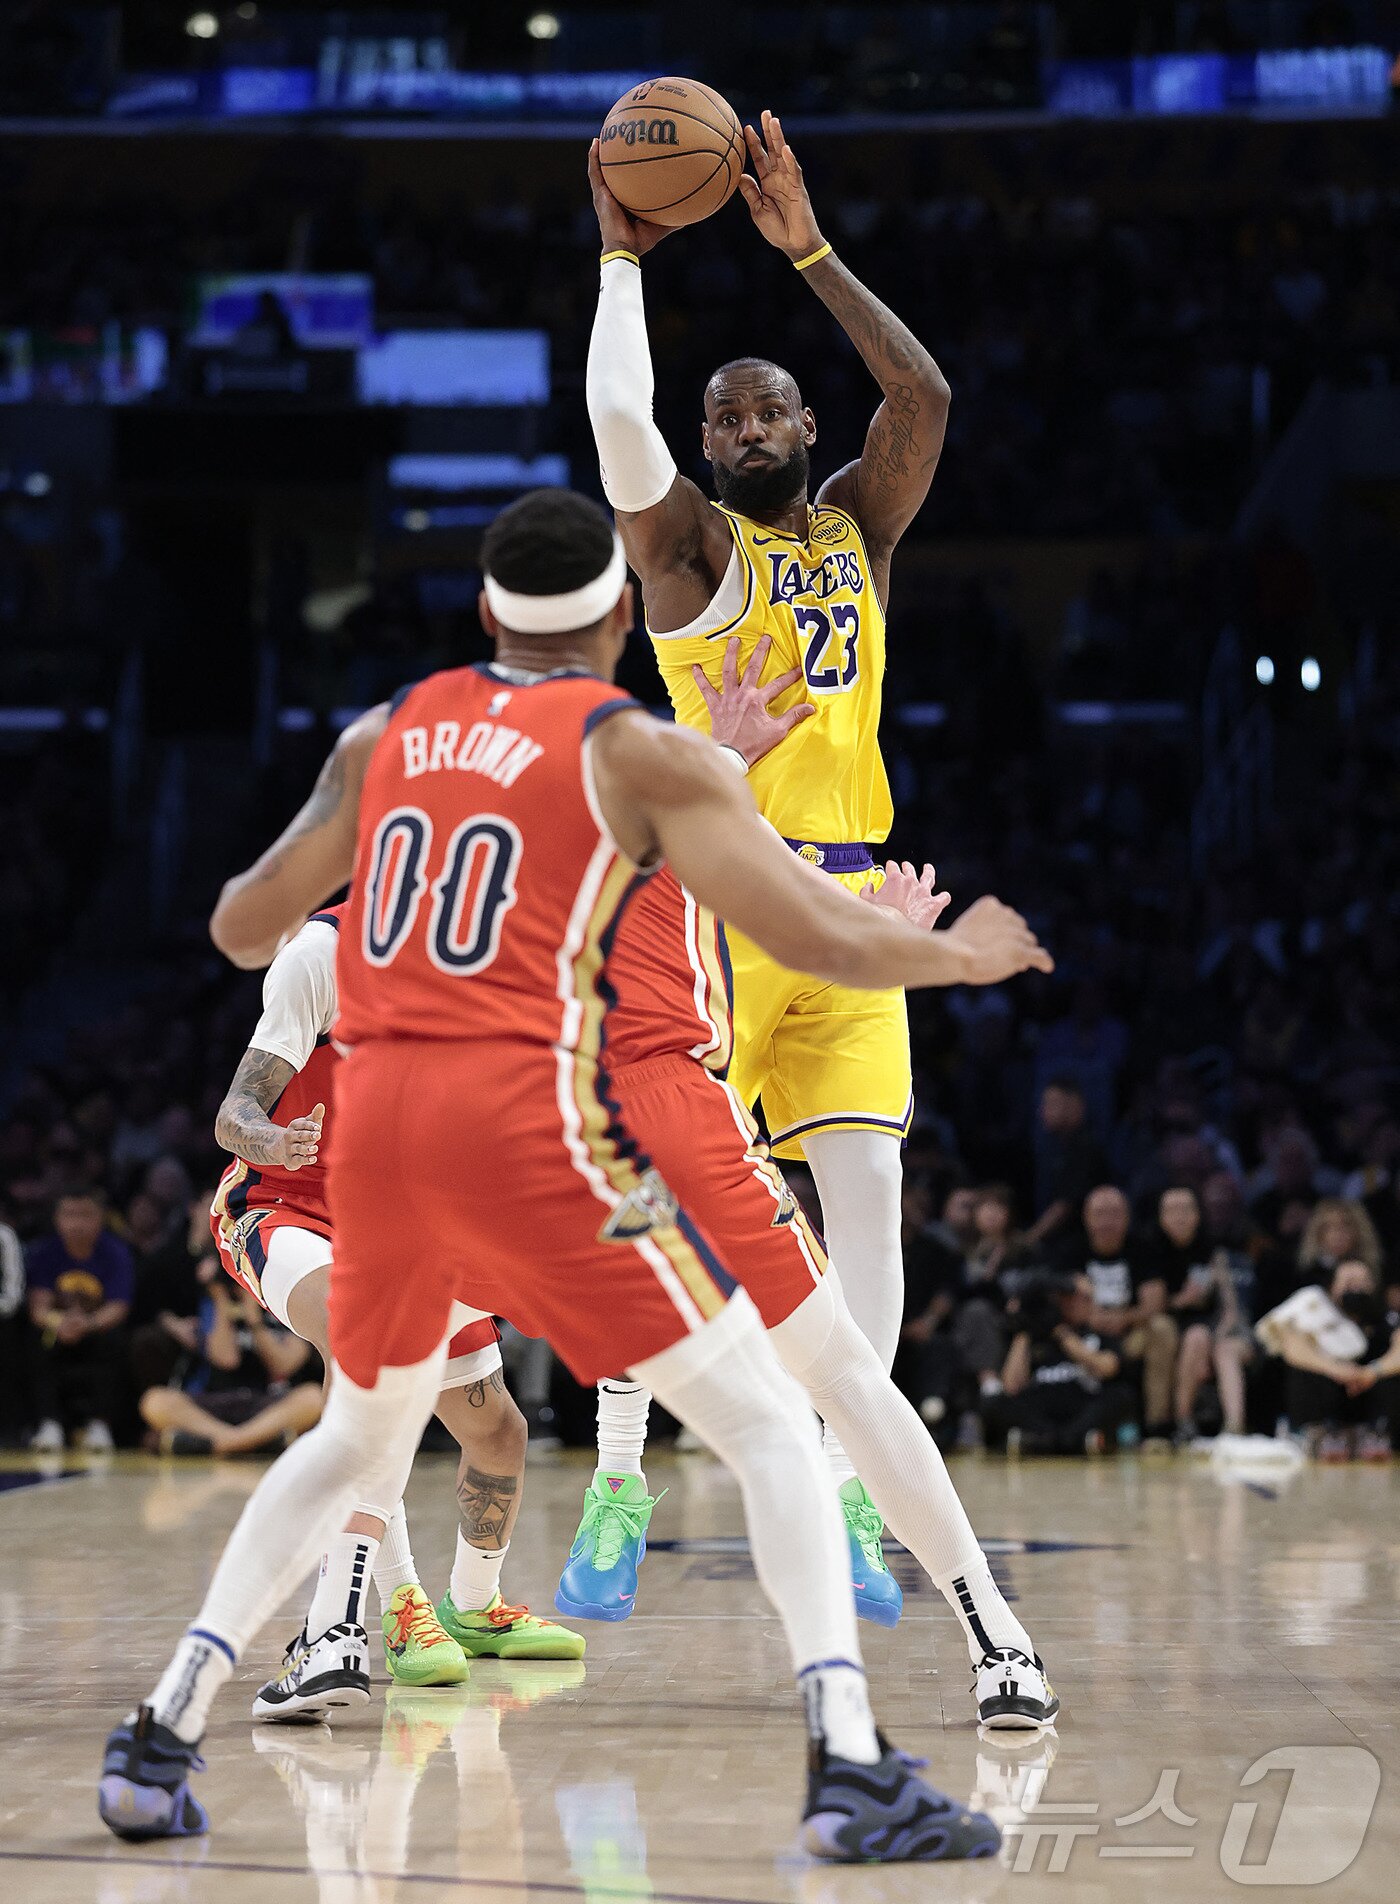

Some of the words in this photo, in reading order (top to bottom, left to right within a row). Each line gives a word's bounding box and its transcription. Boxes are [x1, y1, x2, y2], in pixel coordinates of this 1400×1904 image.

[601, 118, 679, 146] Wilson
[813, 522, 845, 540] bibigo
[768, 552, 864, 606] LAKERS
[792, 603, 860, 694] 23
[401, 721, 545, 788] BROWN
[362, 806, 524, 977] 00
[1005, 1666, 1012, 1676] 2
